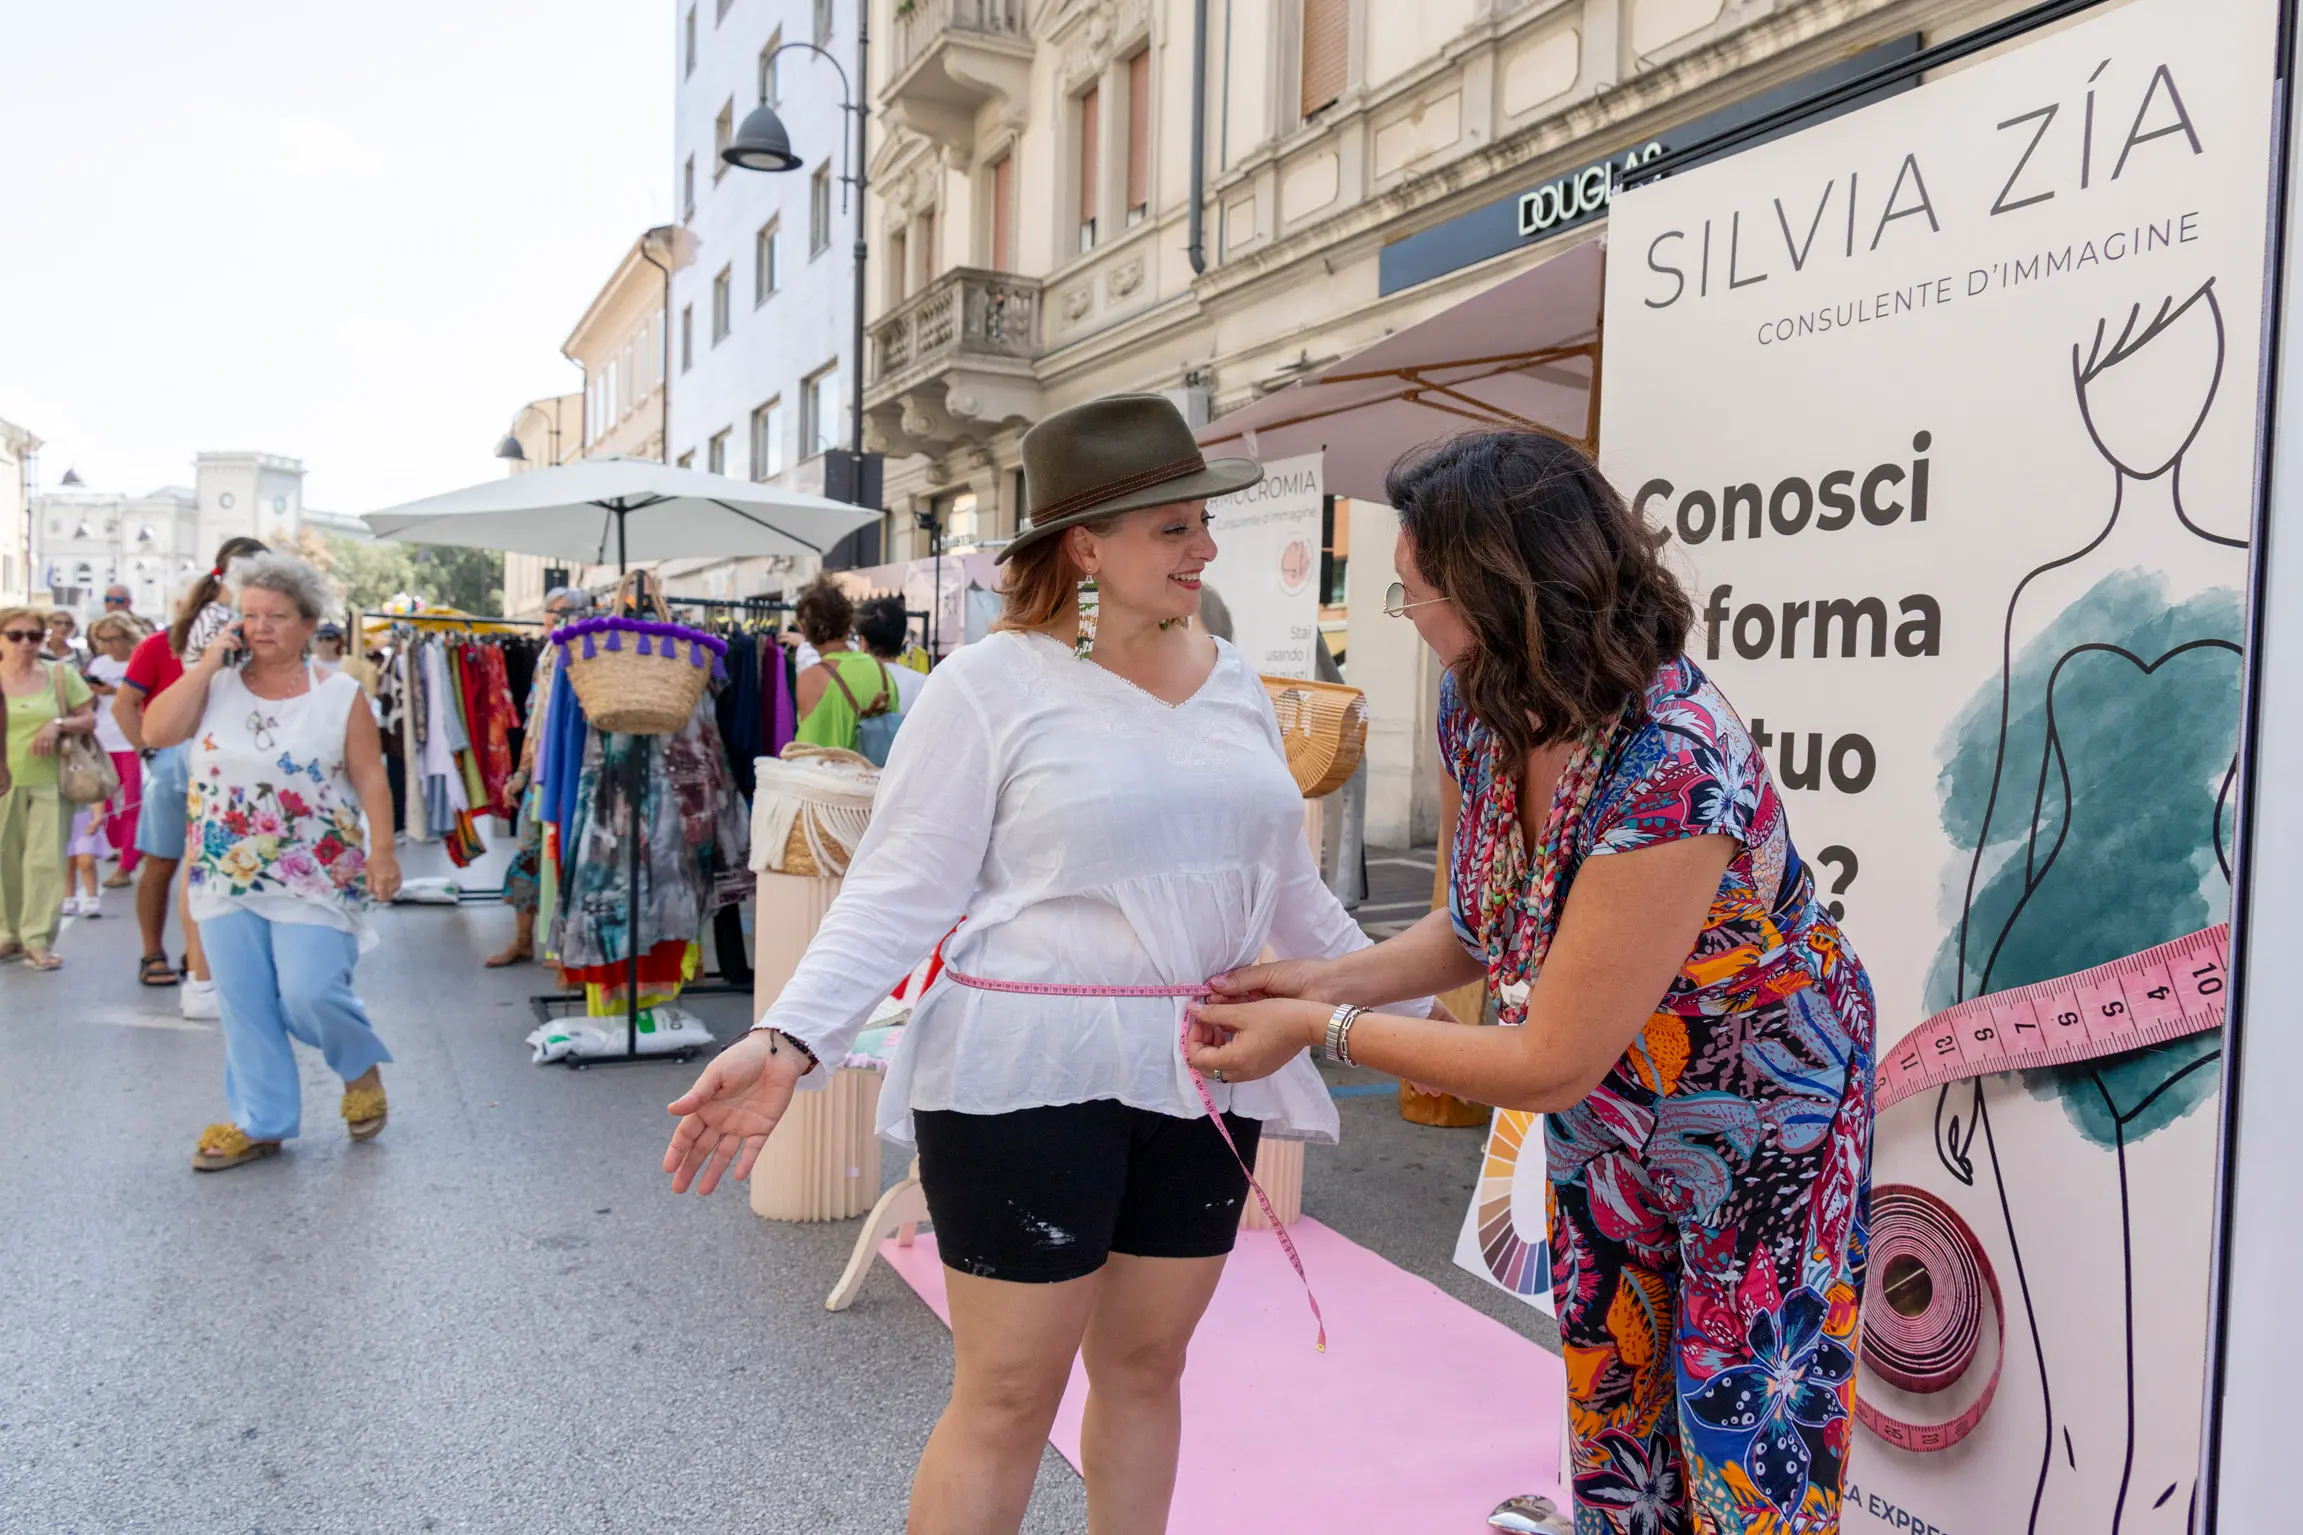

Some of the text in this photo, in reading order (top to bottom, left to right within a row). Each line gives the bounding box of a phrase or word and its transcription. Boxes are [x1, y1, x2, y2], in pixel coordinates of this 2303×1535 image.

[1643, 57, 2204, 309] SILVIA ZÍA
[1757, 276, 1953, 345] CONSULENTE
[1631, 429, 1933, 550] Conosci
[1290, 624, 1312, 640] Stai
[1703, 583, 1942, 661] forma
[1265, 647, 1304, 662] usando
[2191, 961, 2223, 996] 10
[1867, 1493, 1950, 1535] EXPRE
